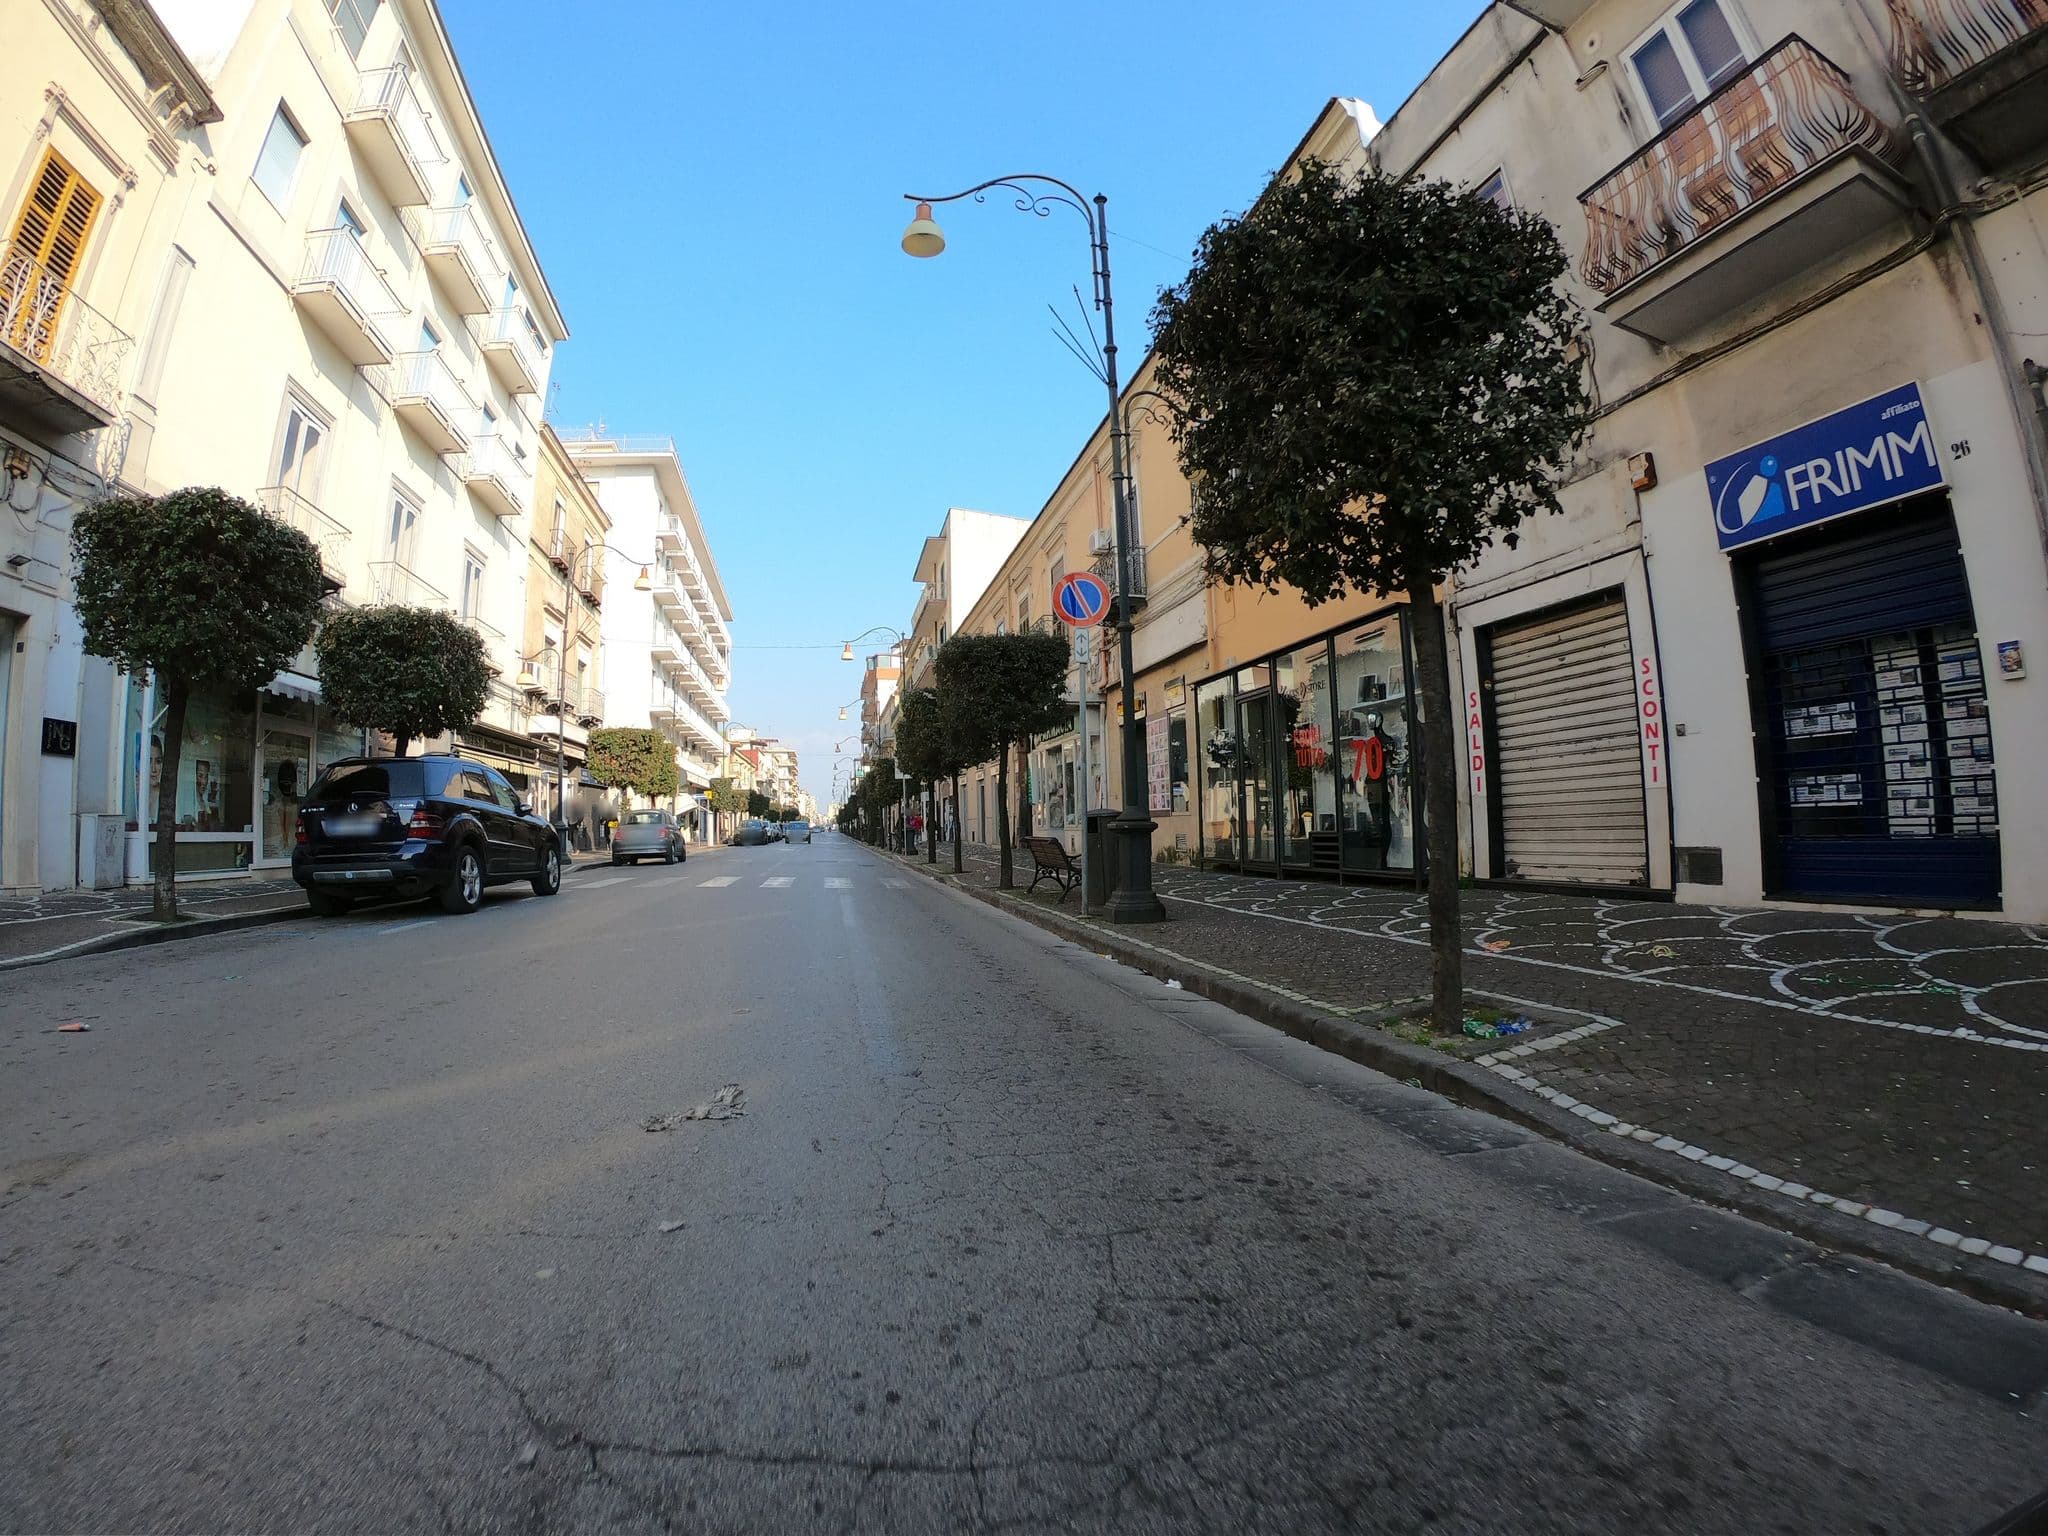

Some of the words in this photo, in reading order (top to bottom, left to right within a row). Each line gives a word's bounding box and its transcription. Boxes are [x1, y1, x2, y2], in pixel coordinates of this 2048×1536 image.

[1880, 400, 1921, 421] affiliato
[1784, 420, 1936, 511] FRIMM
[1950, 440, 1971, 461] 26
[1469, 691, 1484, 792] SALDI
[1641, 658, 1660, 783] SCONTI
[1350, 736, 1383, 782] 70
